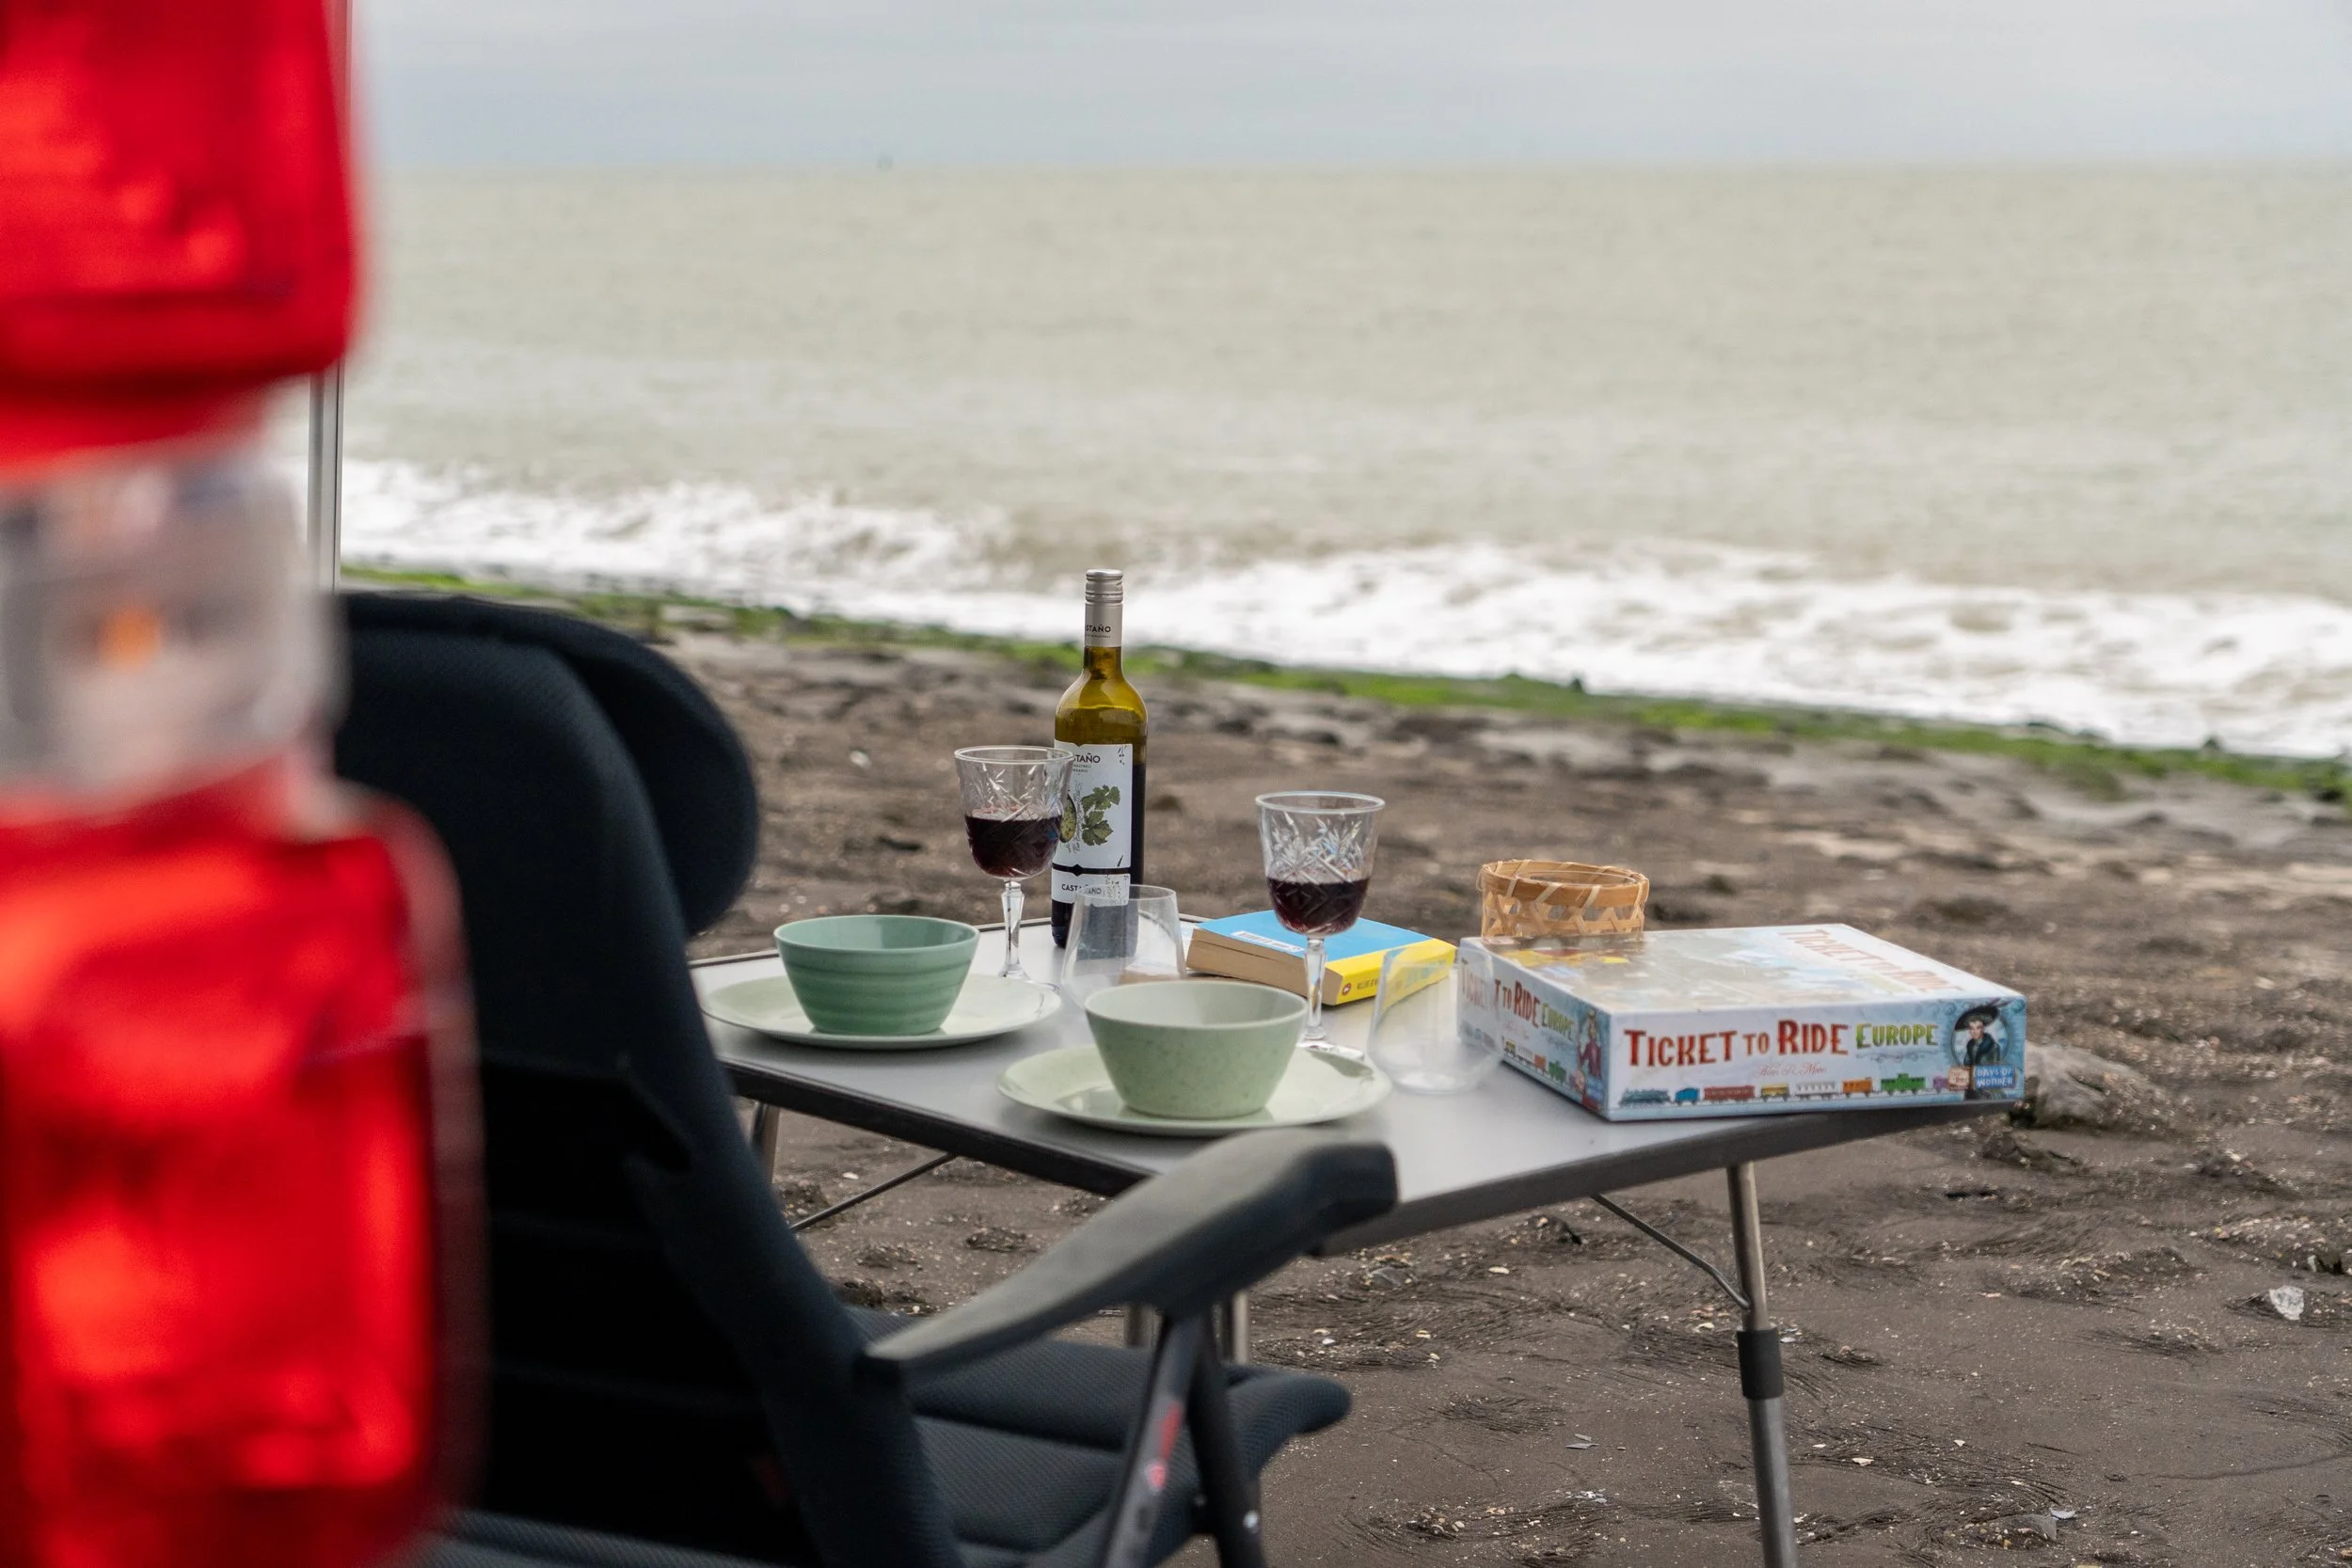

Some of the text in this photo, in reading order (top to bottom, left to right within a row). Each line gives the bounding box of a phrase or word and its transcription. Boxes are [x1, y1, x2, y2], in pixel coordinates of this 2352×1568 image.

[1085, 624, 1111, 633] STAÑO
[1073, 752, 1101, 763] TAÑO
[1502, 986, 1512, 1010] TO
[1513, 980, 1541, 1028] RIDE
[1624, 1019, 1939, 1067] TICKET TO RIDE EUROPE
[1978, 1069, 1999, 1077] DAYS
[1977, 1077, 2013, 1087] WONDER
